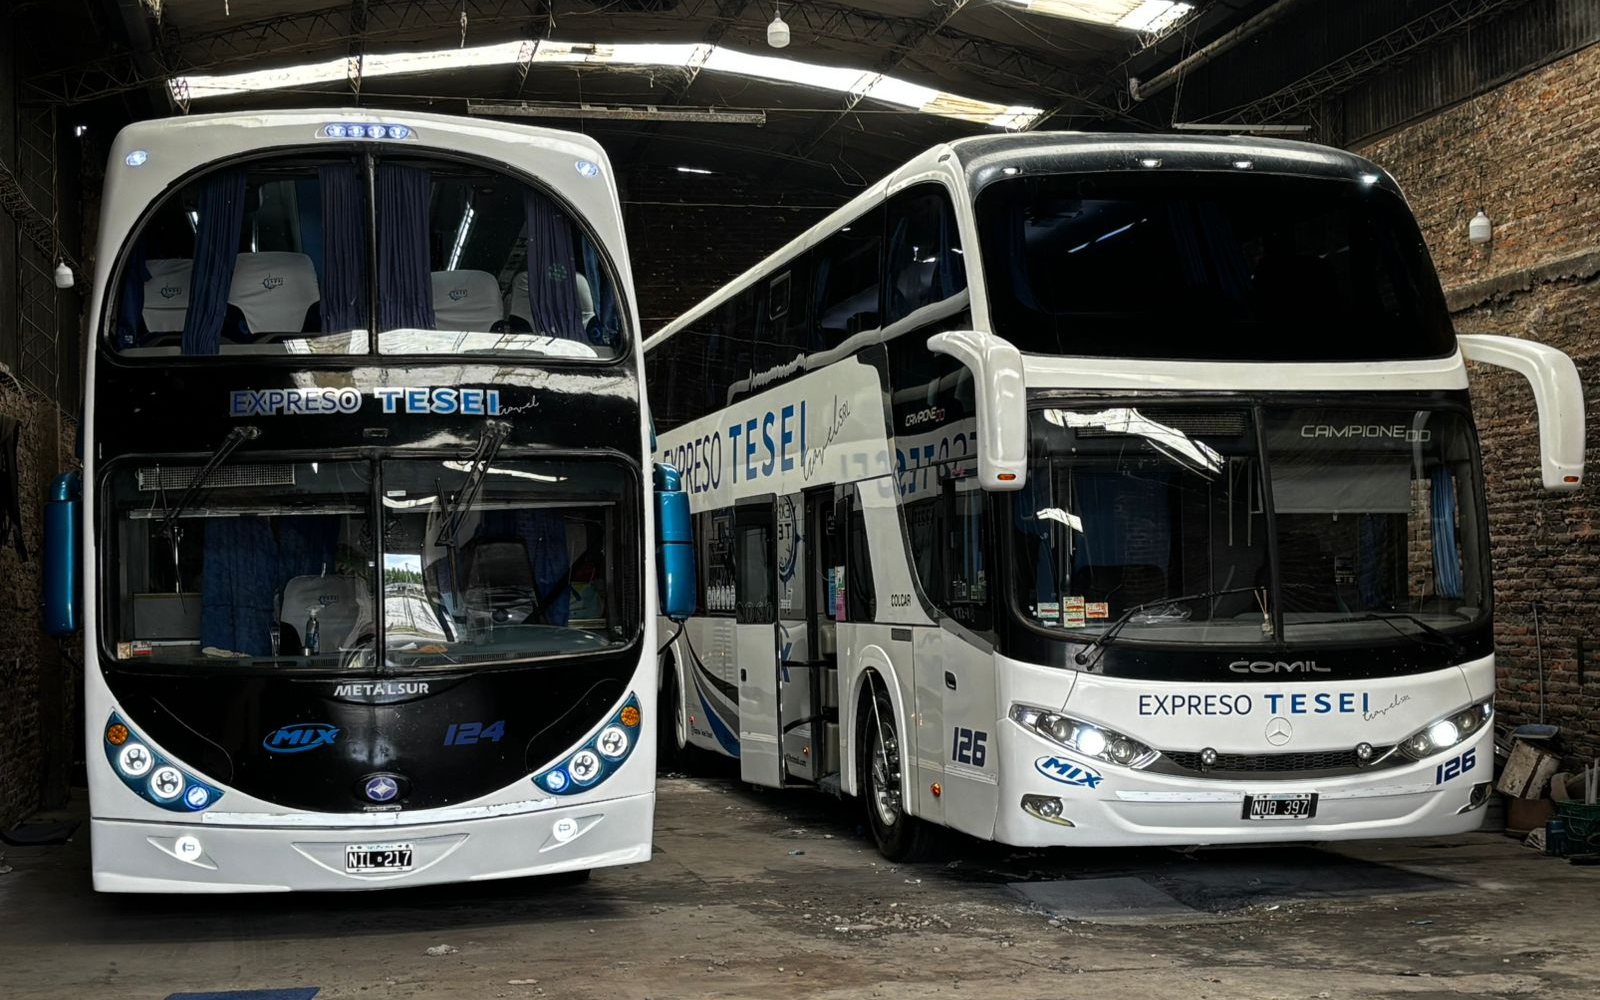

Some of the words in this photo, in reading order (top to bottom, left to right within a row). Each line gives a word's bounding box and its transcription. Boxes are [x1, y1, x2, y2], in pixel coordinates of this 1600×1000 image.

[230, 387, 362, 417] EXPRESO
[374, 387, 500, 416] TESEI
[498, 395, 540, 416] travel
[1301, 425, 1406, 438] CAMPIONE
[664, 431, 722, 495] PRESO
[729, 400, 806, 484] TESEI
[891, 594, 912, 607] COLCAR
[1229, 660, 1331, 673] COMIL
[334, 682, 430, 697] METALSUR
[1139, 694, 1252, 716] EXPRESO
[1264, 692, 1369, 714] TESEI
[1362, 694, 1400, 721] travel
[271, 728, 340, 745] MIX
[443, 720, 506, 746] 124
[952, 726, 988, 768] 126
[1041, 756, 1104, 790] MIX
[1435, 747, 1476, 785] 126
[1253, 800, 1277, 815] NUB
[1284, 800, 1308, 815] 397
[349, 852, 375, 868] NIL
[384, 850, 411, 867] 217
